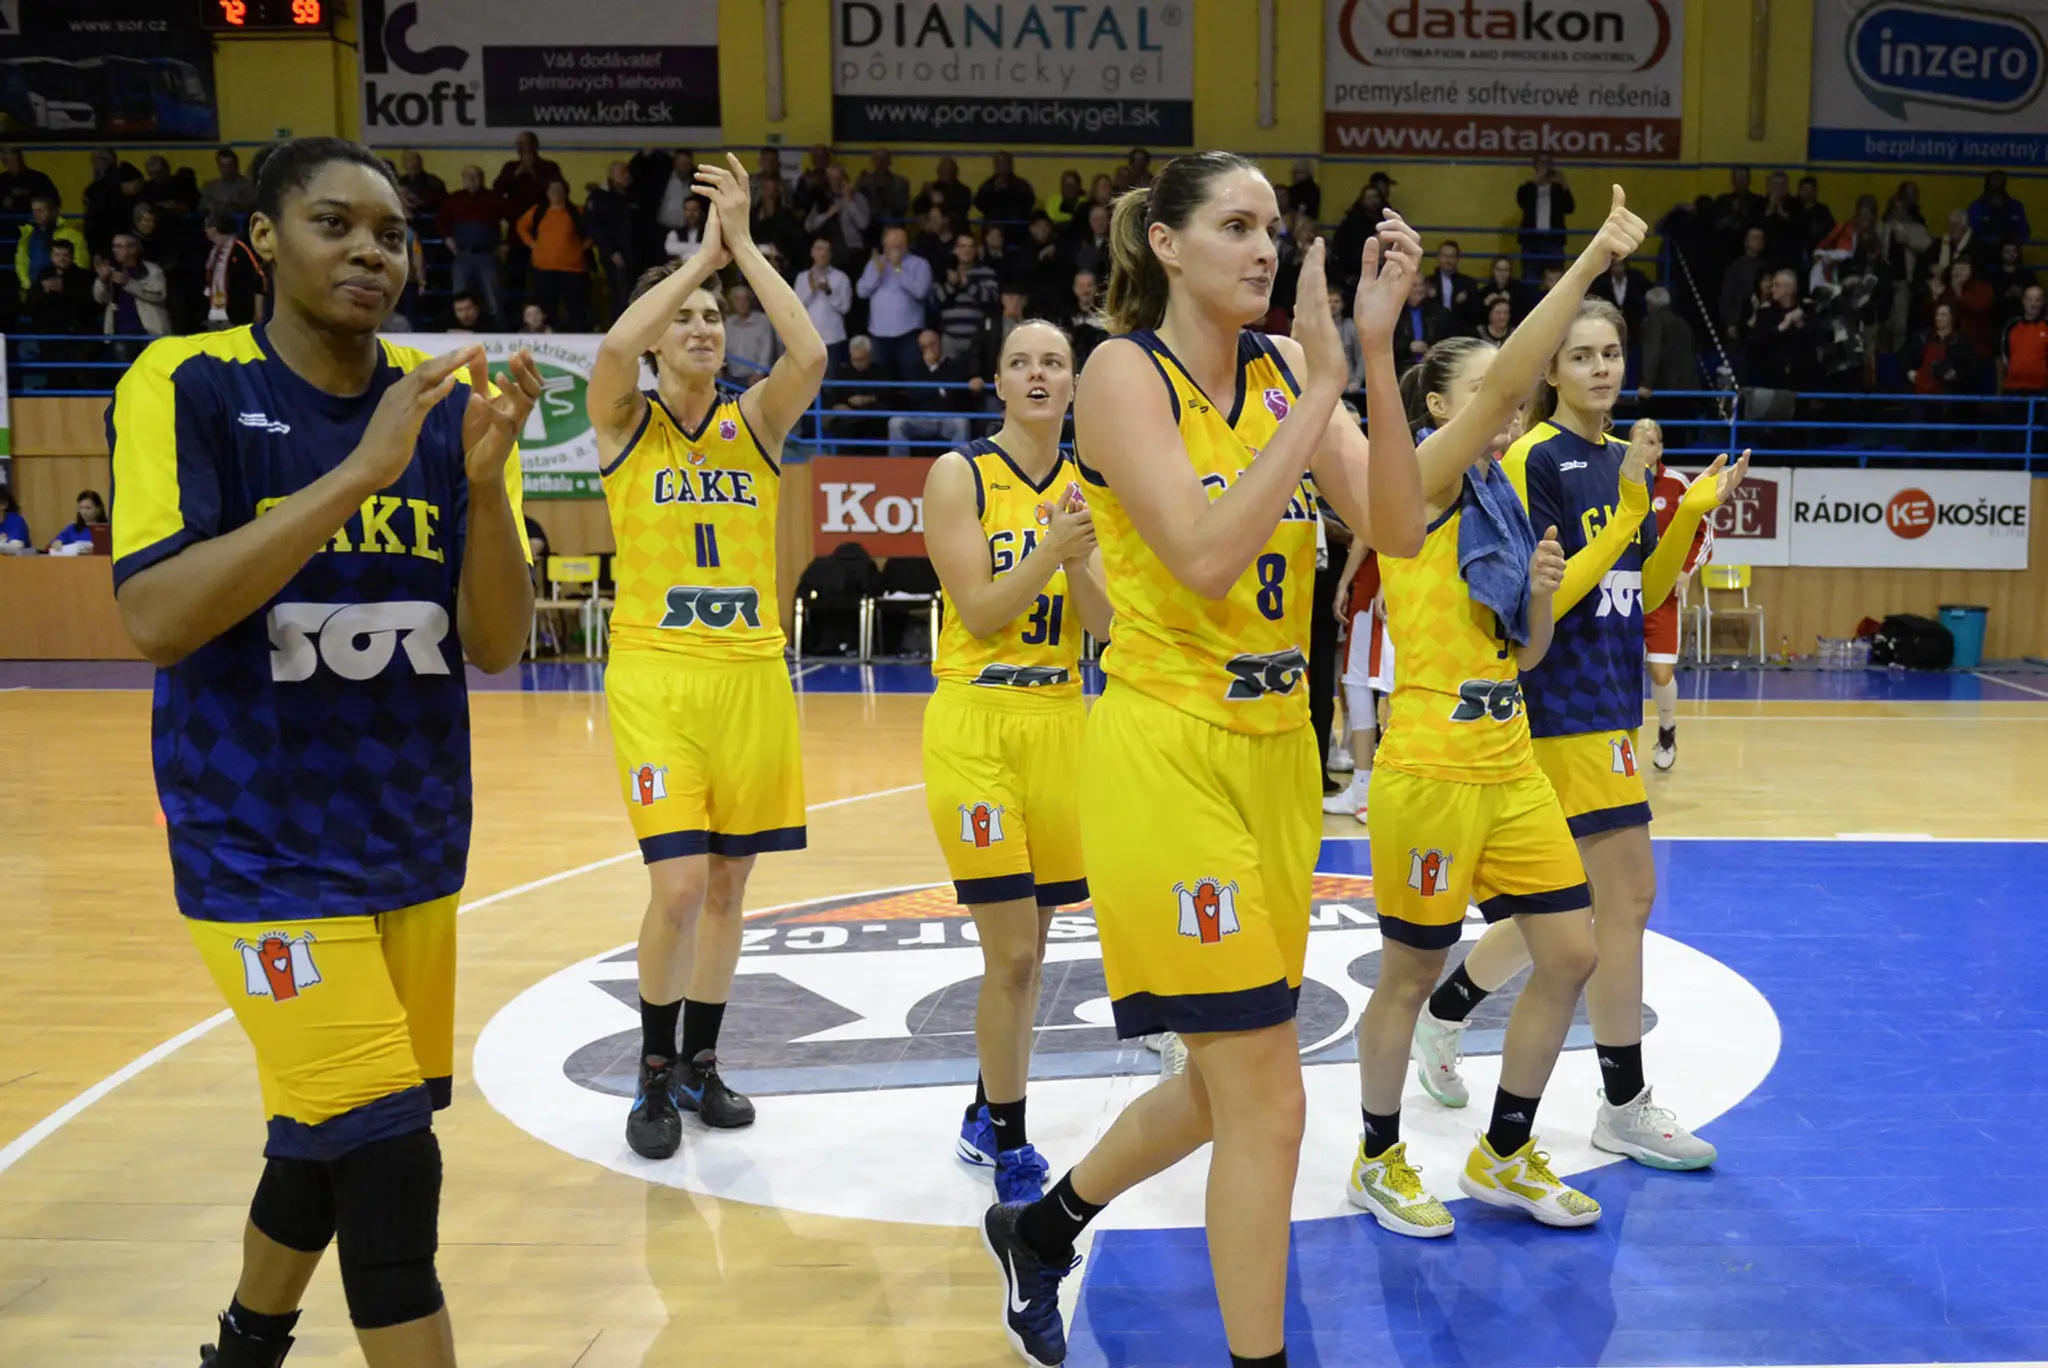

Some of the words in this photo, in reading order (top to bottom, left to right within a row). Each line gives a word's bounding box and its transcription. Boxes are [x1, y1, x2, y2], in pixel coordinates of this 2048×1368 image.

[68, 19, 168, 32] www.sor.cz
[1387, 0, 1624, 41] datakon
[542, 52, 575, 69] Váš
[1374, 47, 1465, 60] AUTOMATION
[1469, 49, 1498, 61] AND
[1502, 50, 1568, 61] PROCESS
[1571, 51, 1637, 62] CONTROL
[1879, 27, 2029, 80] inzero
[366, 81, 477, 127] koft
[1335, 80, 1457, 106] premyslené
[1467, 82, 1579, 106] softvérové
[1588, 83, 1671, 108] riešenia
[533, 100, 673, 124] www.koft.sk
[865, 102, 1160, 131] www.porodnickygel.sk
[1335, 121, 1665, 153] www.datakon.sk
[1864, 134, 1958, 159] bezplatný
[1963, 138, 2040, 162] inzertný
[654, 467, 757, 508] GAKE
[1794, 494, 1883, 524] RÁDIO
[1938, 497, 2026, 526] KOŠICE
[694, 522, 720, 567] 11
[1256, 553, 1287, 621] 8
[1021, 593, 1064, 647] 31
